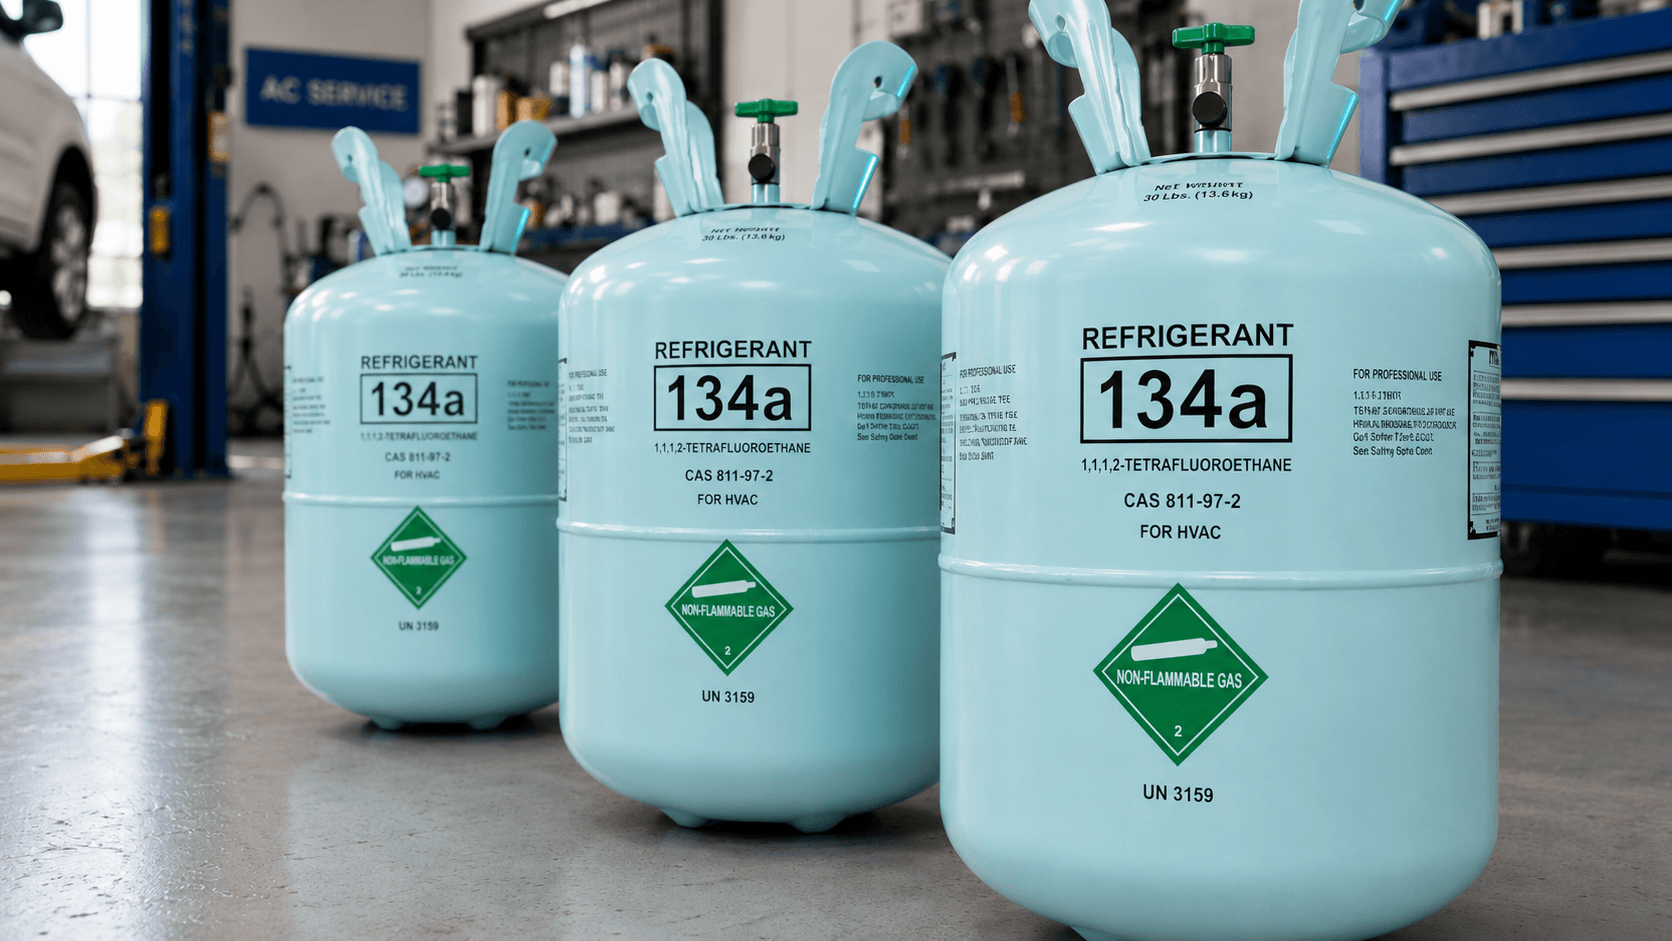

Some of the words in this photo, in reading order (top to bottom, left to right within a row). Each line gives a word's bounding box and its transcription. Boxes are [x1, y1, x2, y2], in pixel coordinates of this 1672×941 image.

[260, 76, 300, 104] AC
[307, 79, 407, 111] SERVICE
[1143, 193, 1160, 202] 30
[1162, 192, 1191, 201] Lbs.
[1082, 323, 1294, 350] REFRIGERANT
[655, 339, 813, 360] REFRIGERANT
[361, 354, 478, 370] REFRIGERANT
[857, 374, 871, 383] FOR
[1353, 368, 1370, 379] FOR
[1372, 369, 1427, 381] PROFESSIONAL
[1429, 371, 1442, 381] USE
[371, 381, 465, 416] 134a
[668, 374, 793, 421] 134a
[1100, 368, 1268, 430] 134a
[654, 442, 811, 454] 1,1,1,2-TETRAFLUOROETHANE
[385, 452, 406, 462] CAS
[408, 452, 451, 462] 811-97-2
[1081, 457, 1292, 474] 1,1,1,2-TETRAFLUOROETHANE
[394, 470, 413, 480] FOR
[415, 470, 440, 480] HVAC
[685, 469, 713, 482] CAS
[716, 469, 774, 482] 811-97-2
[697, 493, 722, 505] FOR
[725, 493, 758, 506] HVAC
[1124, 492, 1160, 509] CAS
[1166, 492, 1241, 509] 811-97-2
[1140, 524, 1173, 539] FOR
[1177, 524, 1222, 540] HVAC
[681, 603, 754, 618] NON-FLAMMABLE
[756, 605, 776, 618] GAS
[398, 621, 414, 631] UN
[417, 621, 440, 631] 3159
[724, 645, 731, 656] 2
[1116, 668, 1215, 688] NON-FLAMMABLE
[1217, 672, 1243, 689] GAS
[702, 689, 721, 703] UN
[724, 690, 755, 703] 3159
[1174, 724, 1183, 737] 2
[1143, 783, 1168, 801] UN
[1173, 785, 1214, 803] 3159
